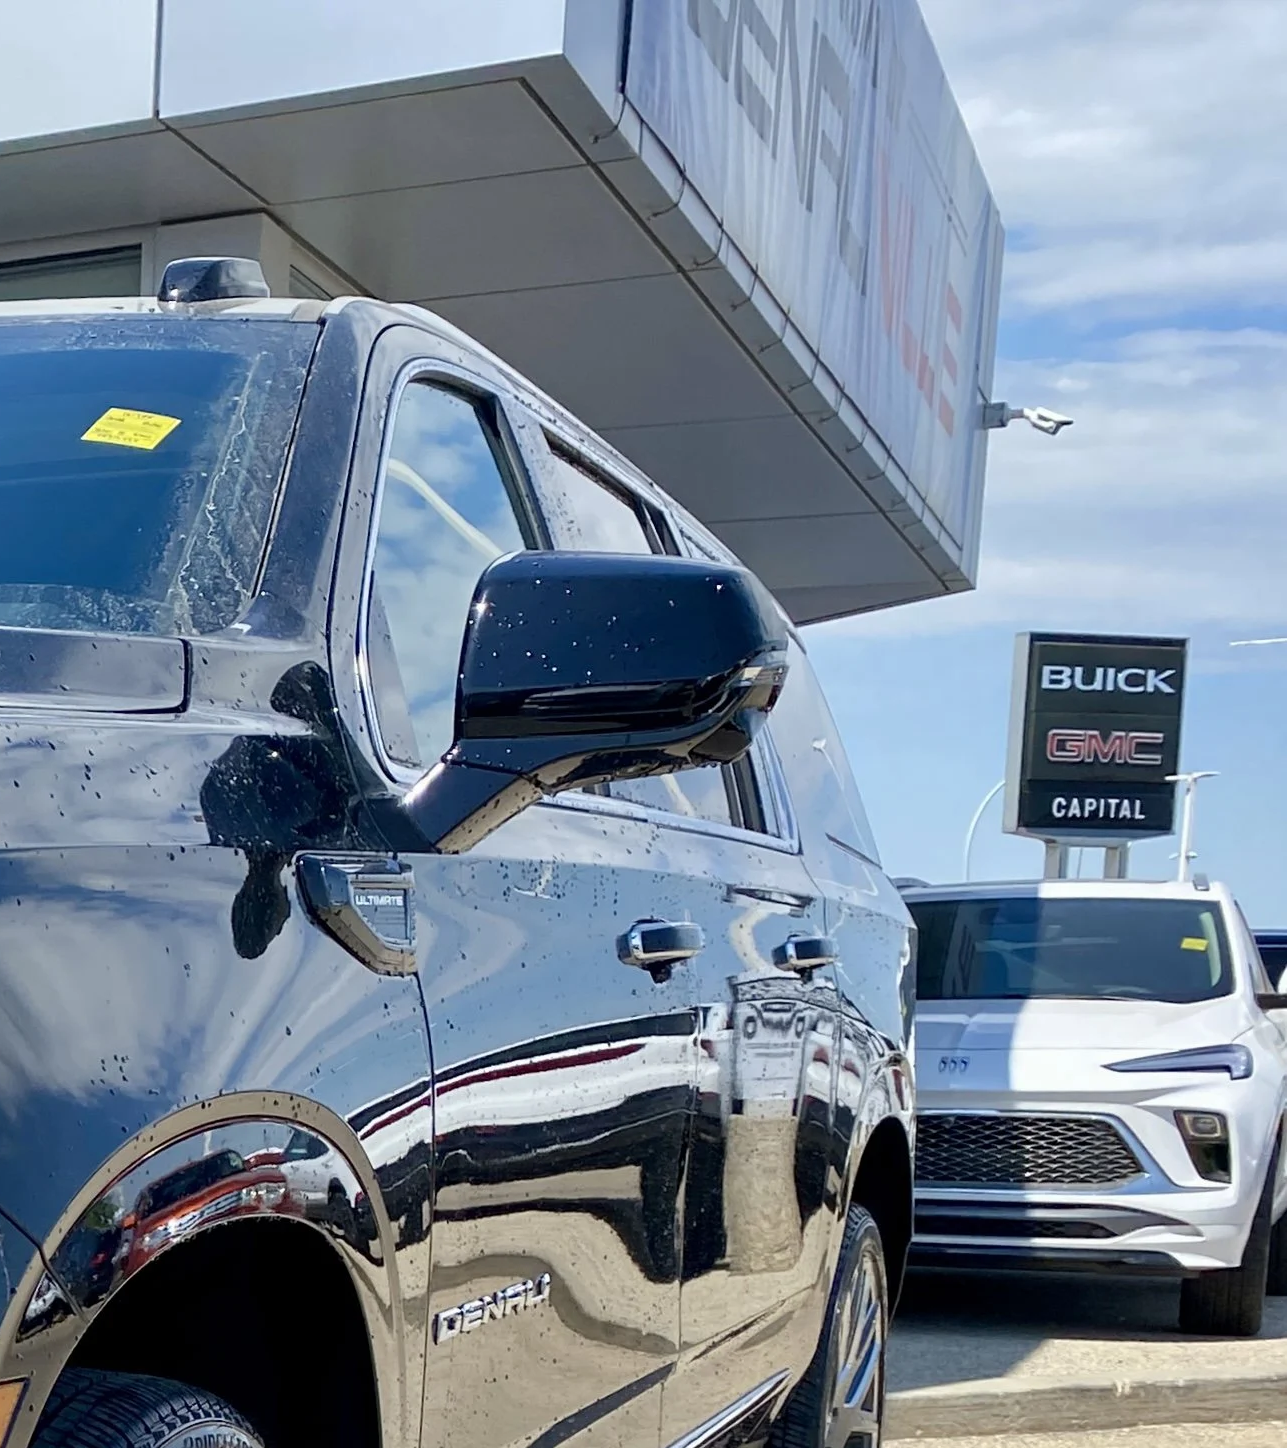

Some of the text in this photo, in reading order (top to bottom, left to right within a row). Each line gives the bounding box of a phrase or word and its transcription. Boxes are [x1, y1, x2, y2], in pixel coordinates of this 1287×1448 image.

[1041, 665, 1176, 694] BUICK
[1046, 728, 1164, 765] GMC
[1051, 797, 1146, 820] CAPITAL
[432, 1272, 551, 1345] DENALI
